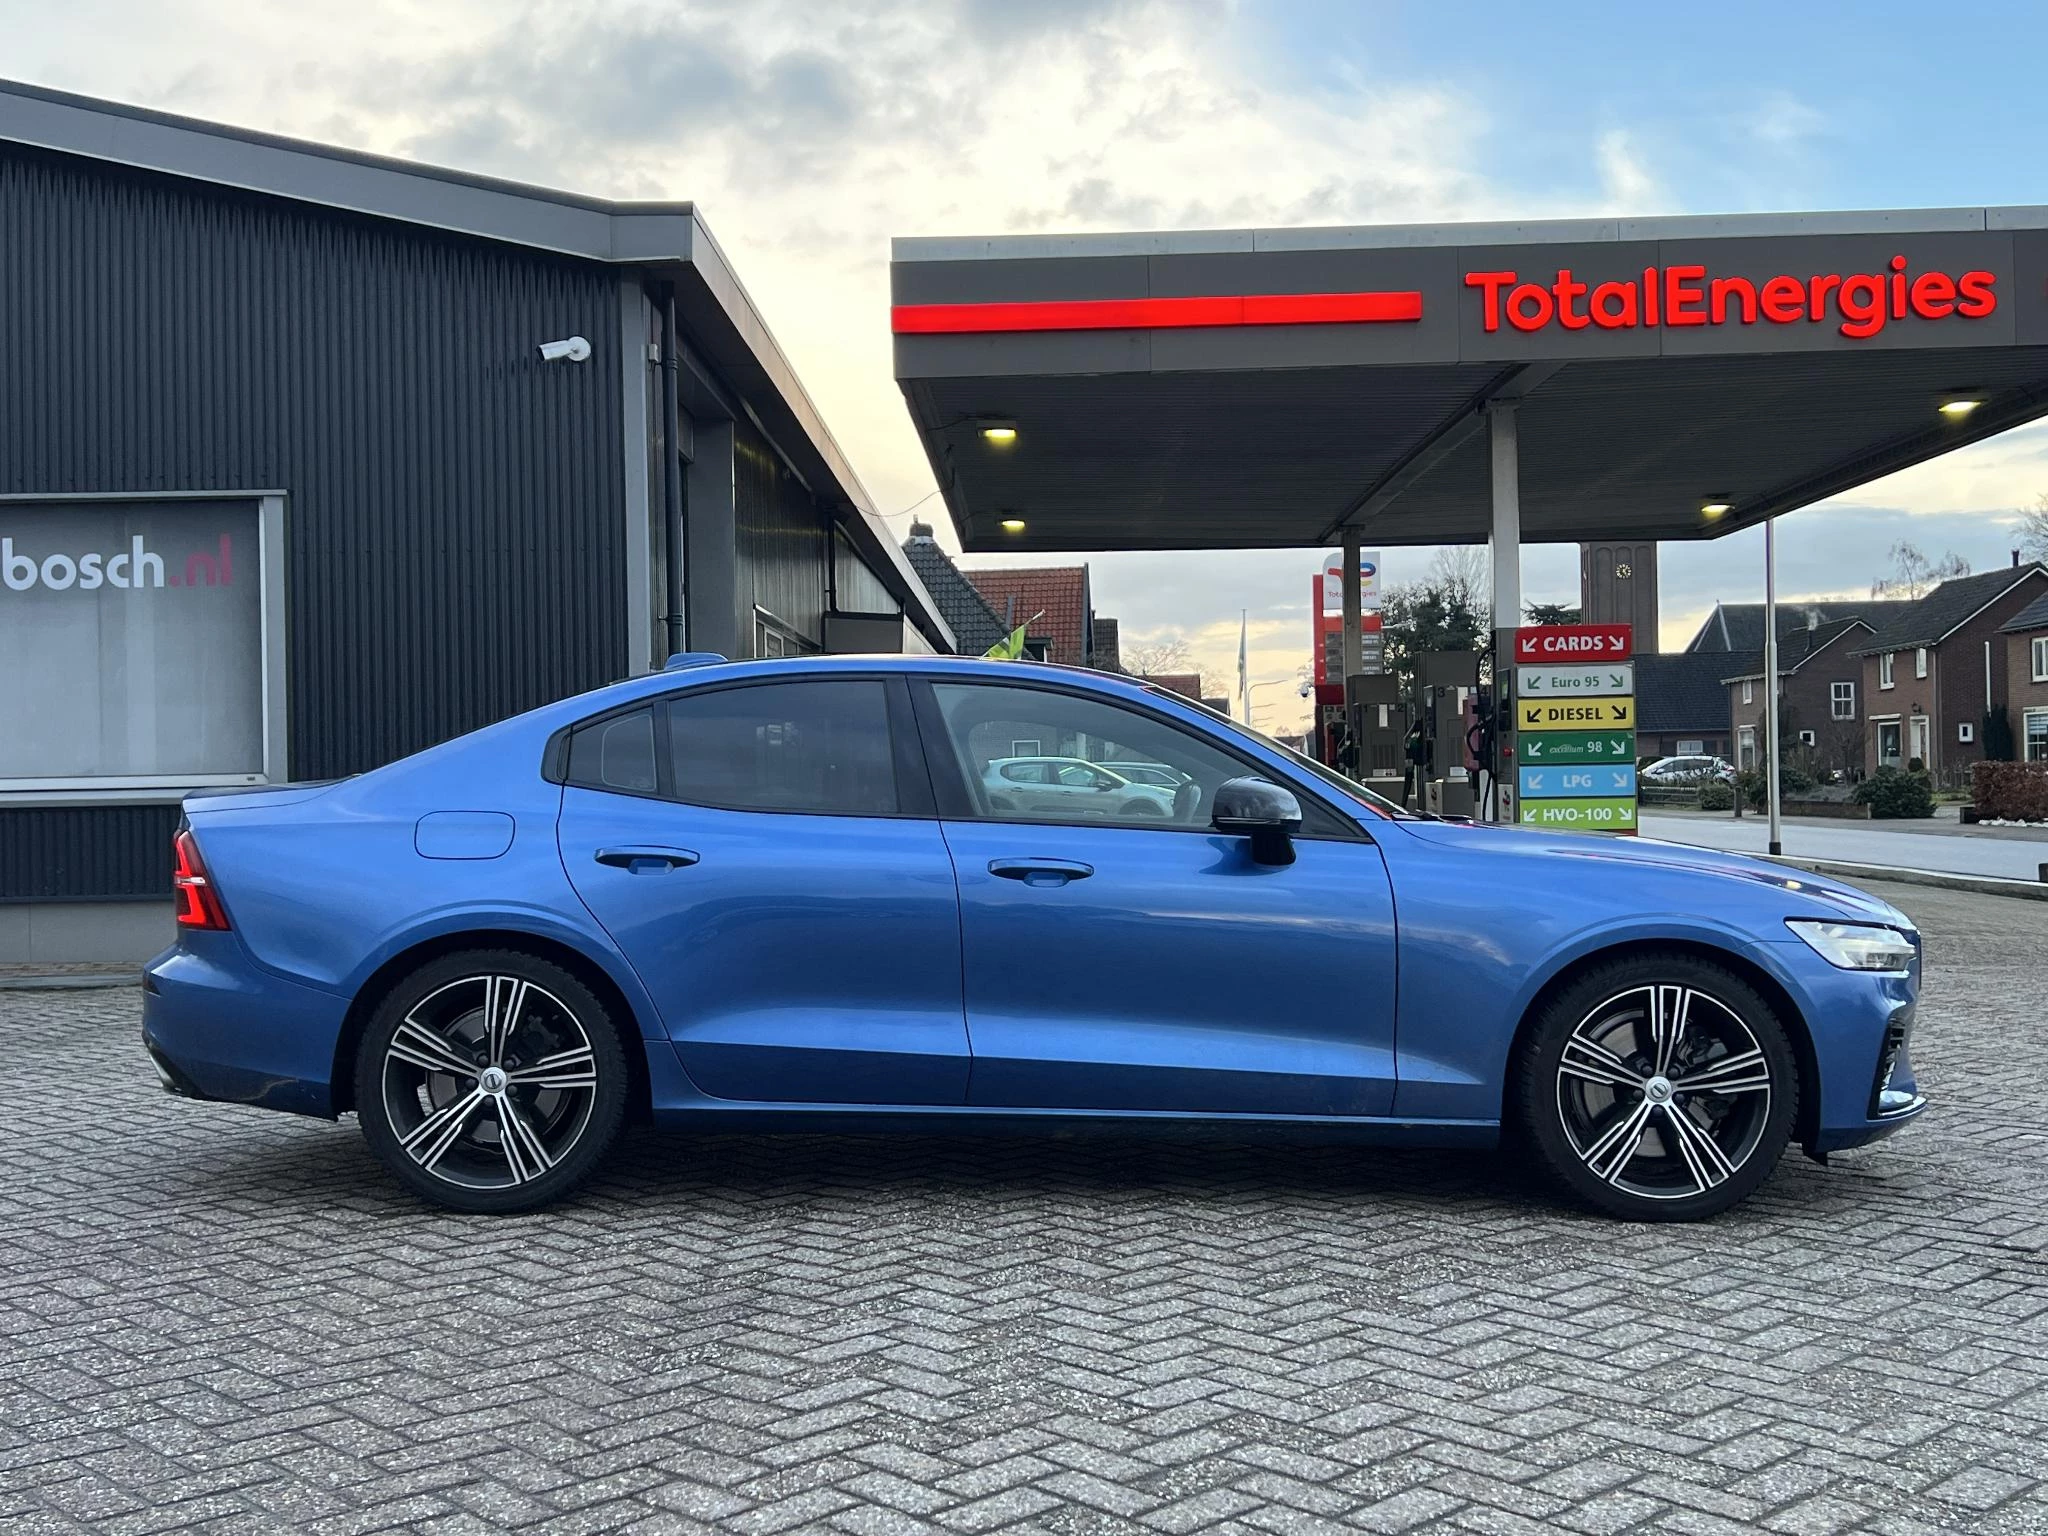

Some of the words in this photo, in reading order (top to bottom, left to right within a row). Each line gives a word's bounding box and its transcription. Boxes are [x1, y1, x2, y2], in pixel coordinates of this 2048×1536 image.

[1465, 255, 1997, 338] TotalEnergies
[2, 533, 233, 591] bosch.nl
[1543, 635, 1604, 652] CARDS
[1551, 676, 1581, 689] Euro
[1584, 675, 1600, 687] 95
[1548, 707, 1604, 721] DIESEL
[1587, 741, 1603, 753] 98
[1563, 774, 1592, 788] LPG
[1543, 808, 1612, 821] HVO-100
